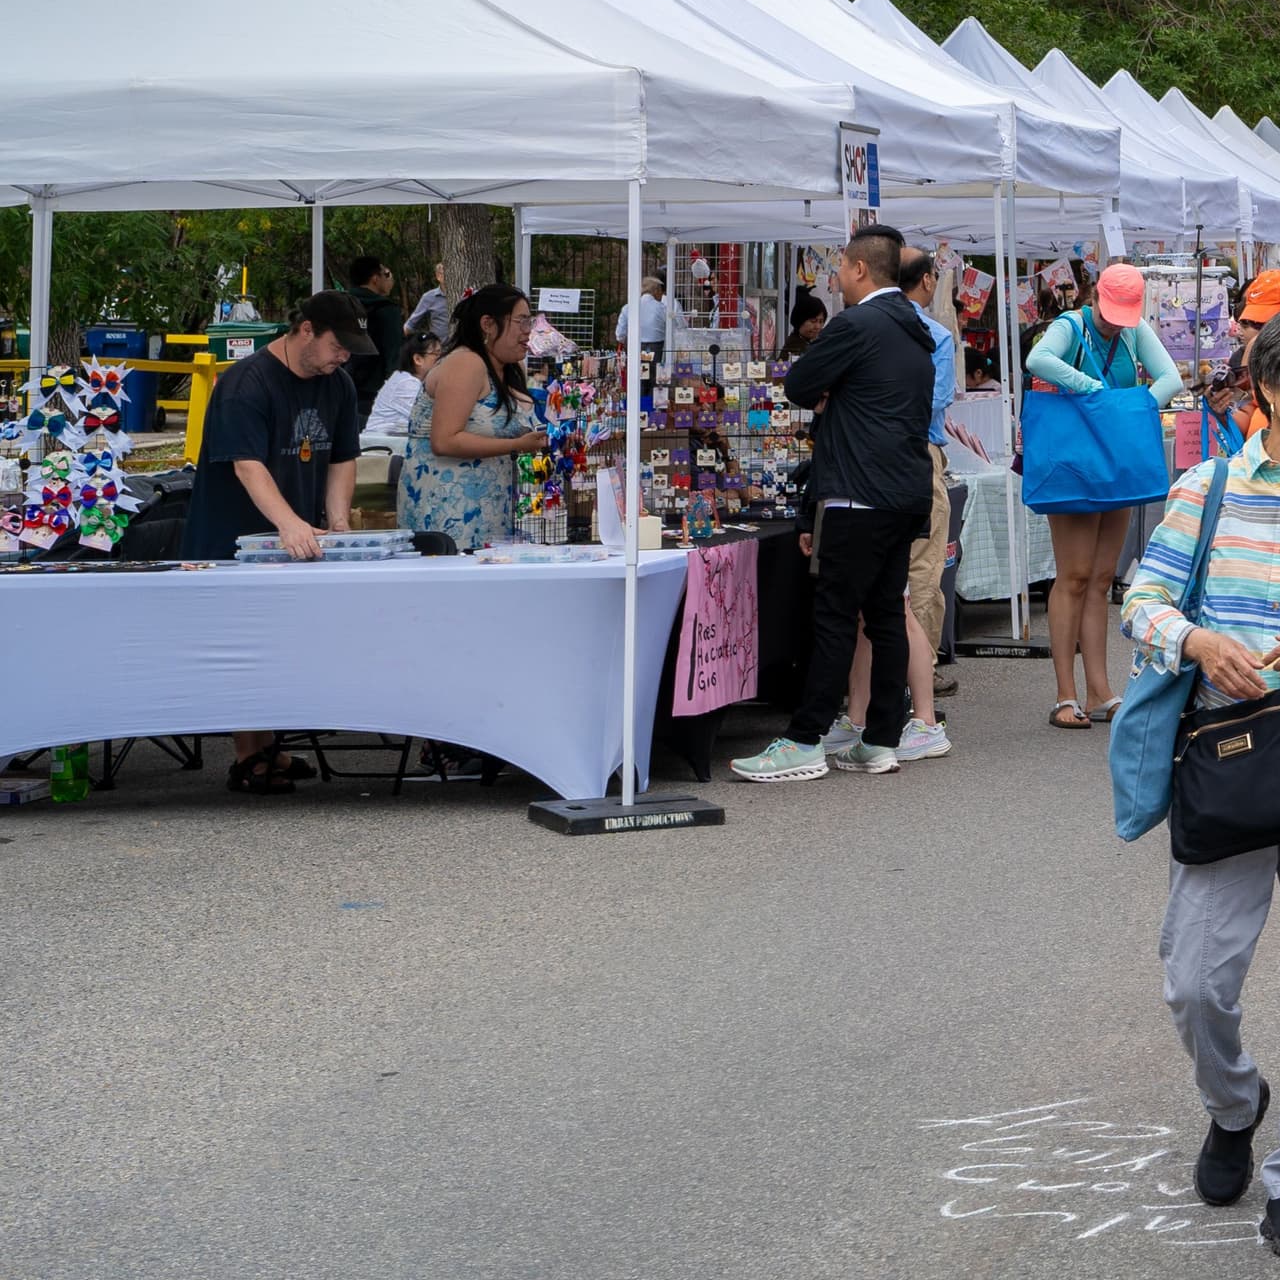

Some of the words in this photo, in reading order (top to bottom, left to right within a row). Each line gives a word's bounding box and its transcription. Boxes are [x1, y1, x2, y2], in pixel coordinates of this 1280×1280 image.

[845, 144, 866, 185] SHOP
[604, 815, 635, 830] URBAN
[635, 811, 695, 827] PRODUCTIONS
